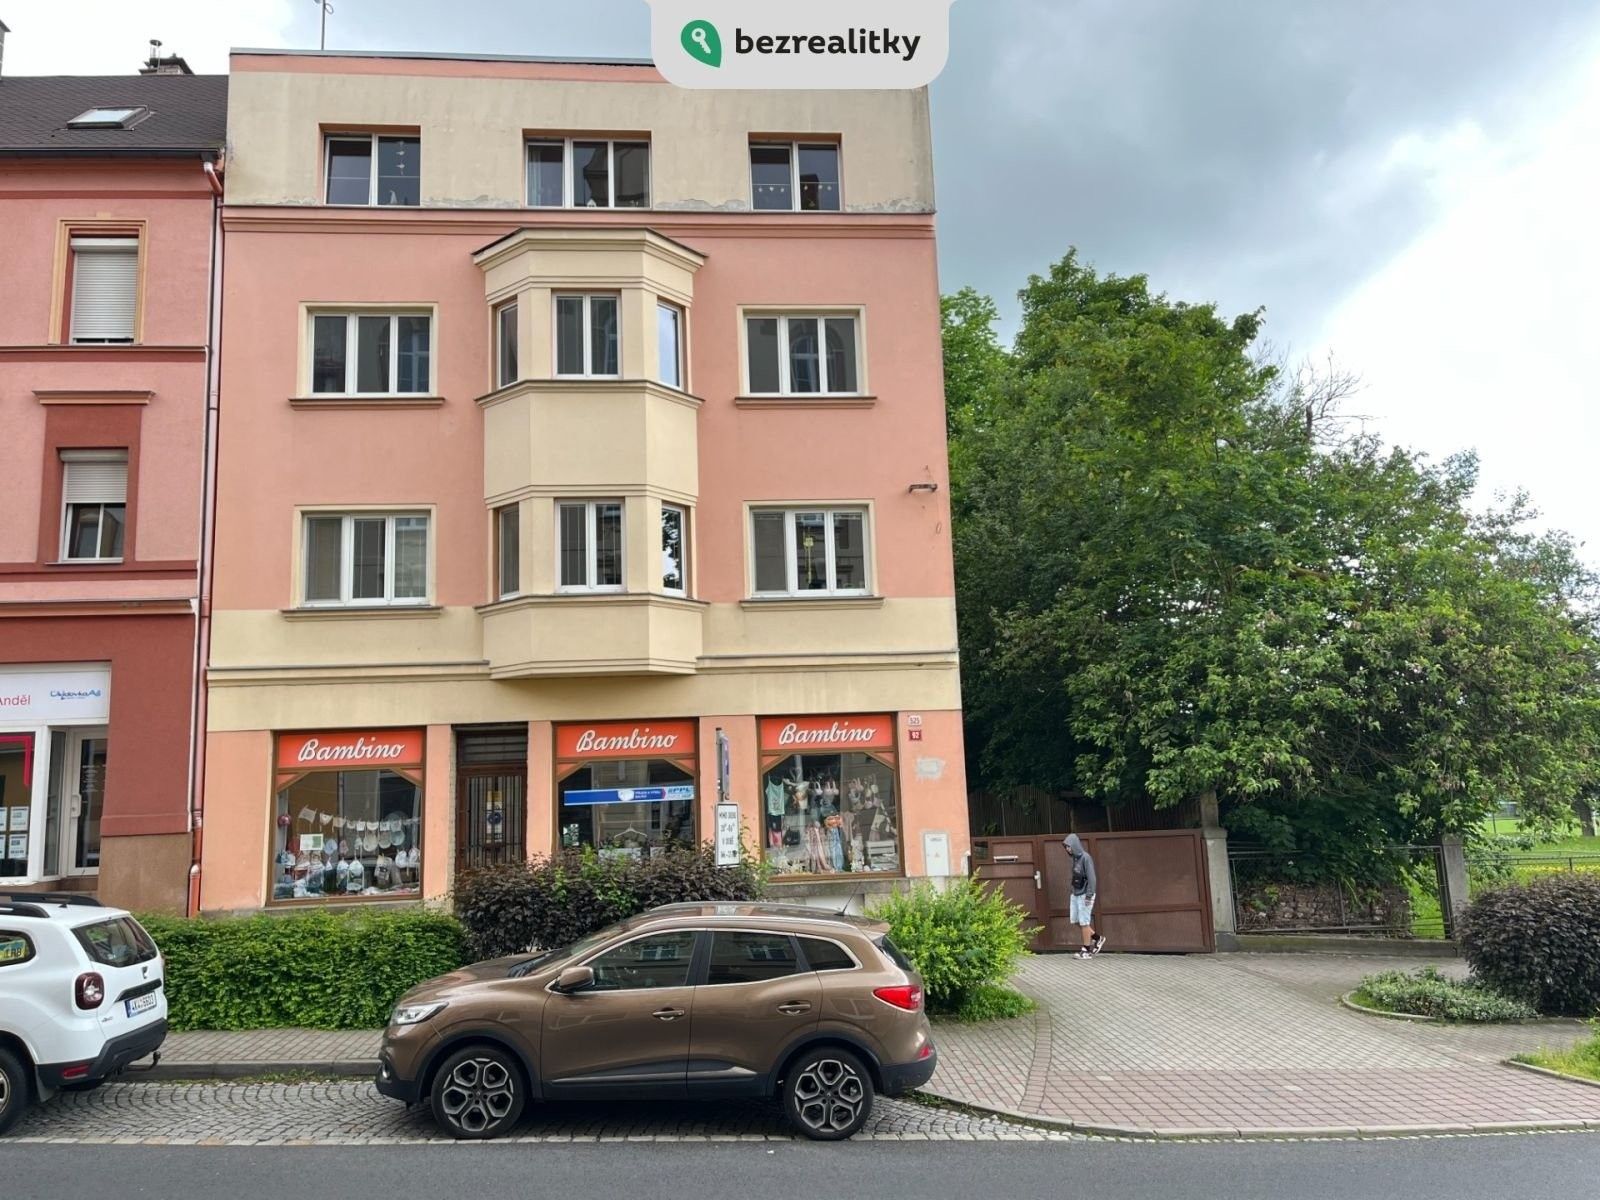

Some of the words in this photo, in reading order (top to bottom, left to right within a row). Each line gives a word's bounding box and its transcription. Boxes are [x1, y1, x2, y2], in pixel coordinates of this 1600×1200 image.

[576, 728, 678, 752] Bambino
[779, 721, 877, 745] Bambino
[298, 737, 405, 761] Bambino
